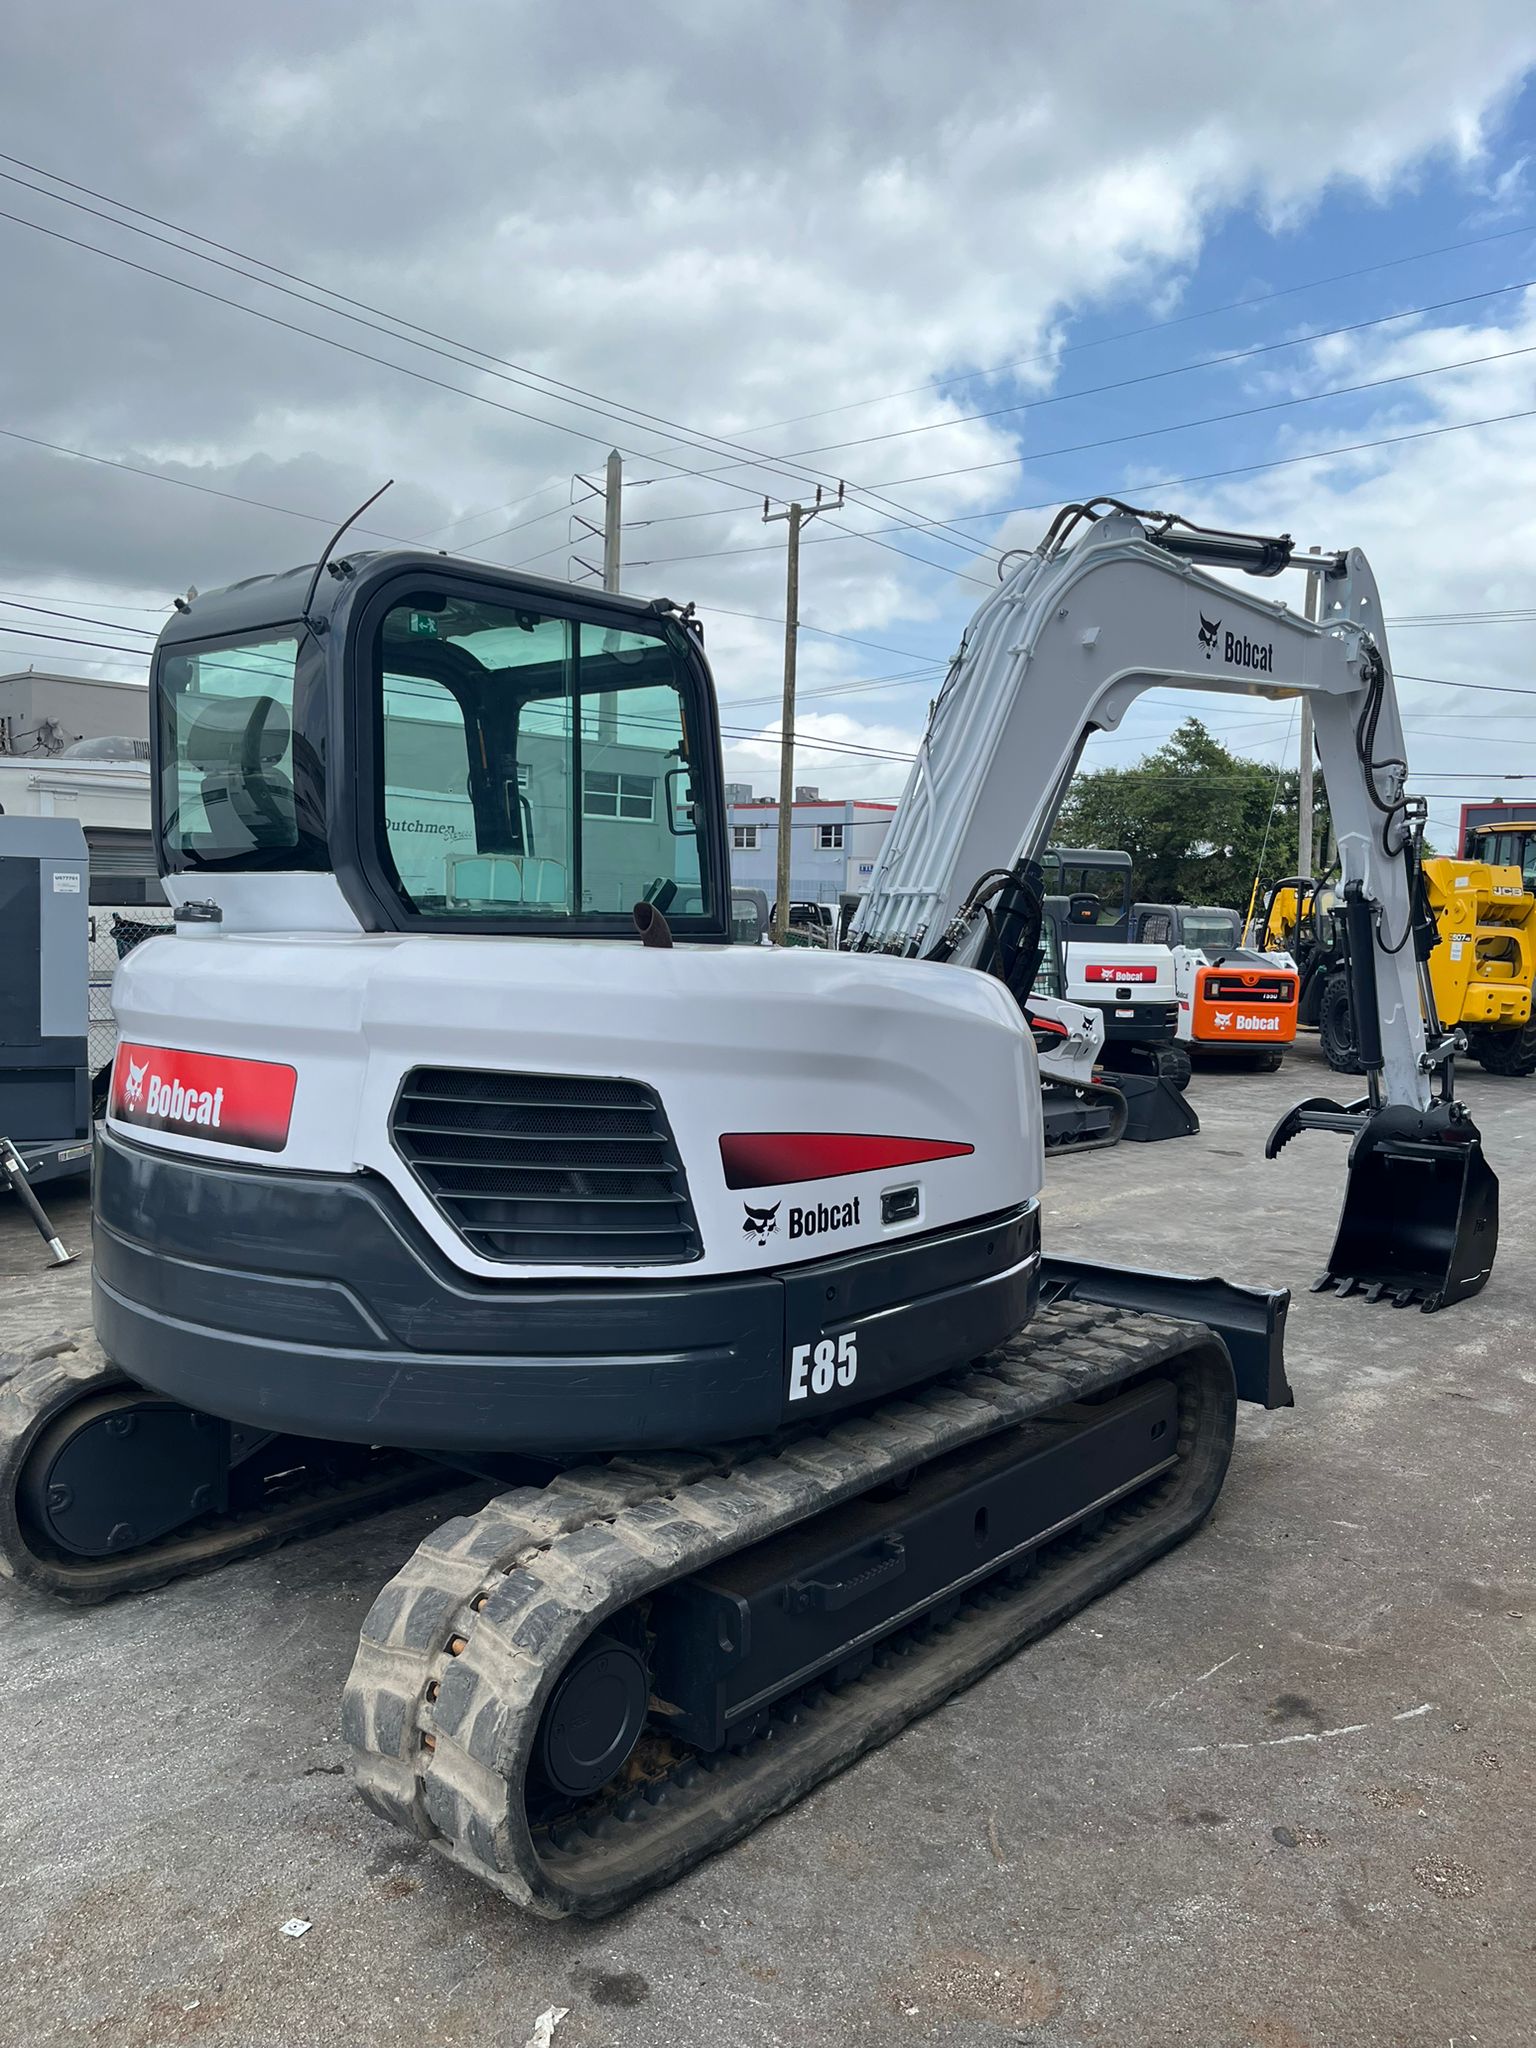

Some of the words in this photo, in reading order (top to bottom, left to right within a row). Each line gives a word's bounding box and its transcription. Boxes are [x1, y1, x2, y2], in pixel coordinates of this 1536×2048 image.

[1225, 631, 1273, 673] Bobcat
[1493, 886, 1522, 896] JCB
[1115, 971, 1143, 982] Bobcat
[1236, 1015, 1280, 1031] Bobcat
[146, 1074, 224, 1128] Bobcat
[788, 1196, 861, 1240] Bobcat
[788, 1331, 858, 1401] E85
